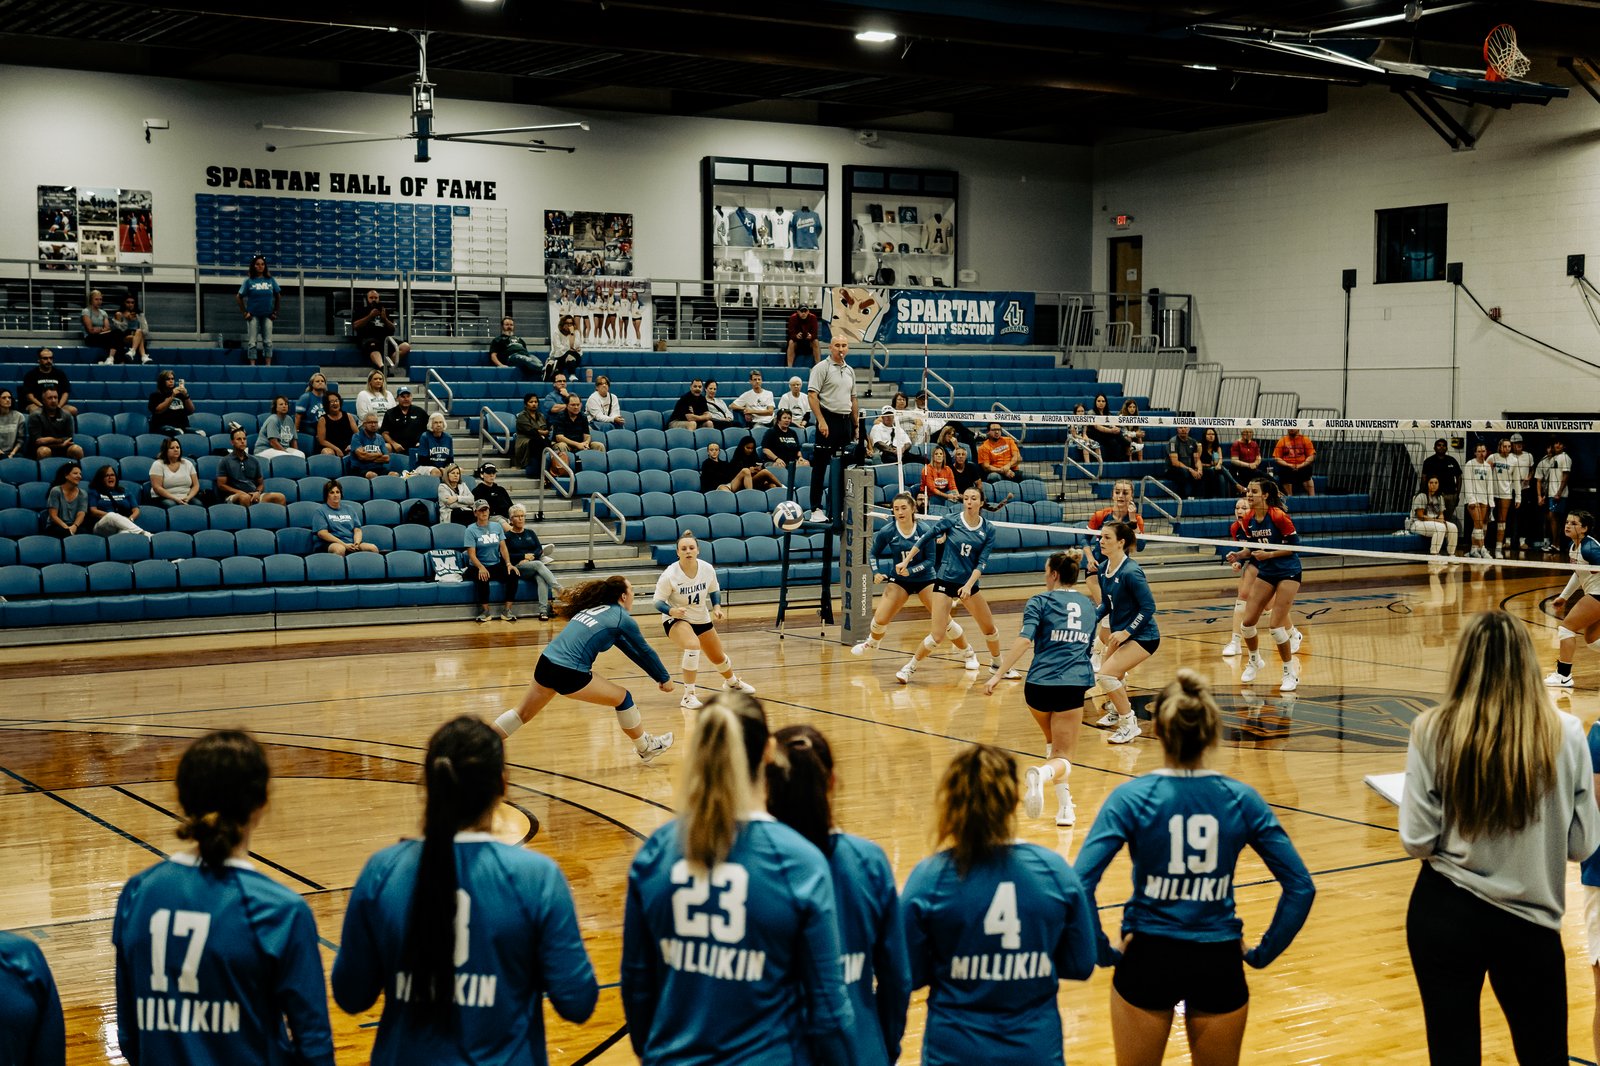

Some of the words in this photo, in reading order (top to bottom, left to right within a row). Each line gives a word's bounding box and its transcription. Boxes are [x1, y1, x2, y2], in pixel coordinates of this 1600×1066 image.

[206, 165, 320, 192] SPARTAN
[329, 172, 391, 196] HALL
[400, 176, 428, 197] OF
[436, 178, 497, 201] FAME
[897, 298, 995, 323] SPARTAN
[896, 322, 948, 335] STUDENT
[950, 323, 995, 336] SECTION
[927, 411, 946, 419] AURORA
[946, 412, 975, 420] UNIVERSITY
[994, 413, 1021, 421] SPARTANS
[1063, 415, 1096, 423] UNIVERSITY
[1118, 416, 1149, 424] SPARTANS
[1172, 417, 1197, 425] AURORA
[1198, 418, 1236, 426] UNIVERSITY
[1261, 418, 1298, 427] SPARTANS
[1325, 419, 1354, 428] AURORA
[1355, 419, 1399, 428] UNIVERSITY
[1430, 420, 1472, 429] SPARTANS
[1505, 420, 1539, 430] AURORA
[1541, 421, 1594, 430] UNIVERSITY
[960, 543, 972, 557] 13
[679, 582, 707, 595] MILLIKIN
[687, 594, 701, 605] 14
[1066, 602, 1082, 630] 2
[1167, 813, 1219, 875] 19
[670, 857, 749, 944] 23
[983, 881, 1022, 950] 4
[149, 907, 212, 994] 17
[950, 951, 1053, 981] MILLIKIN
